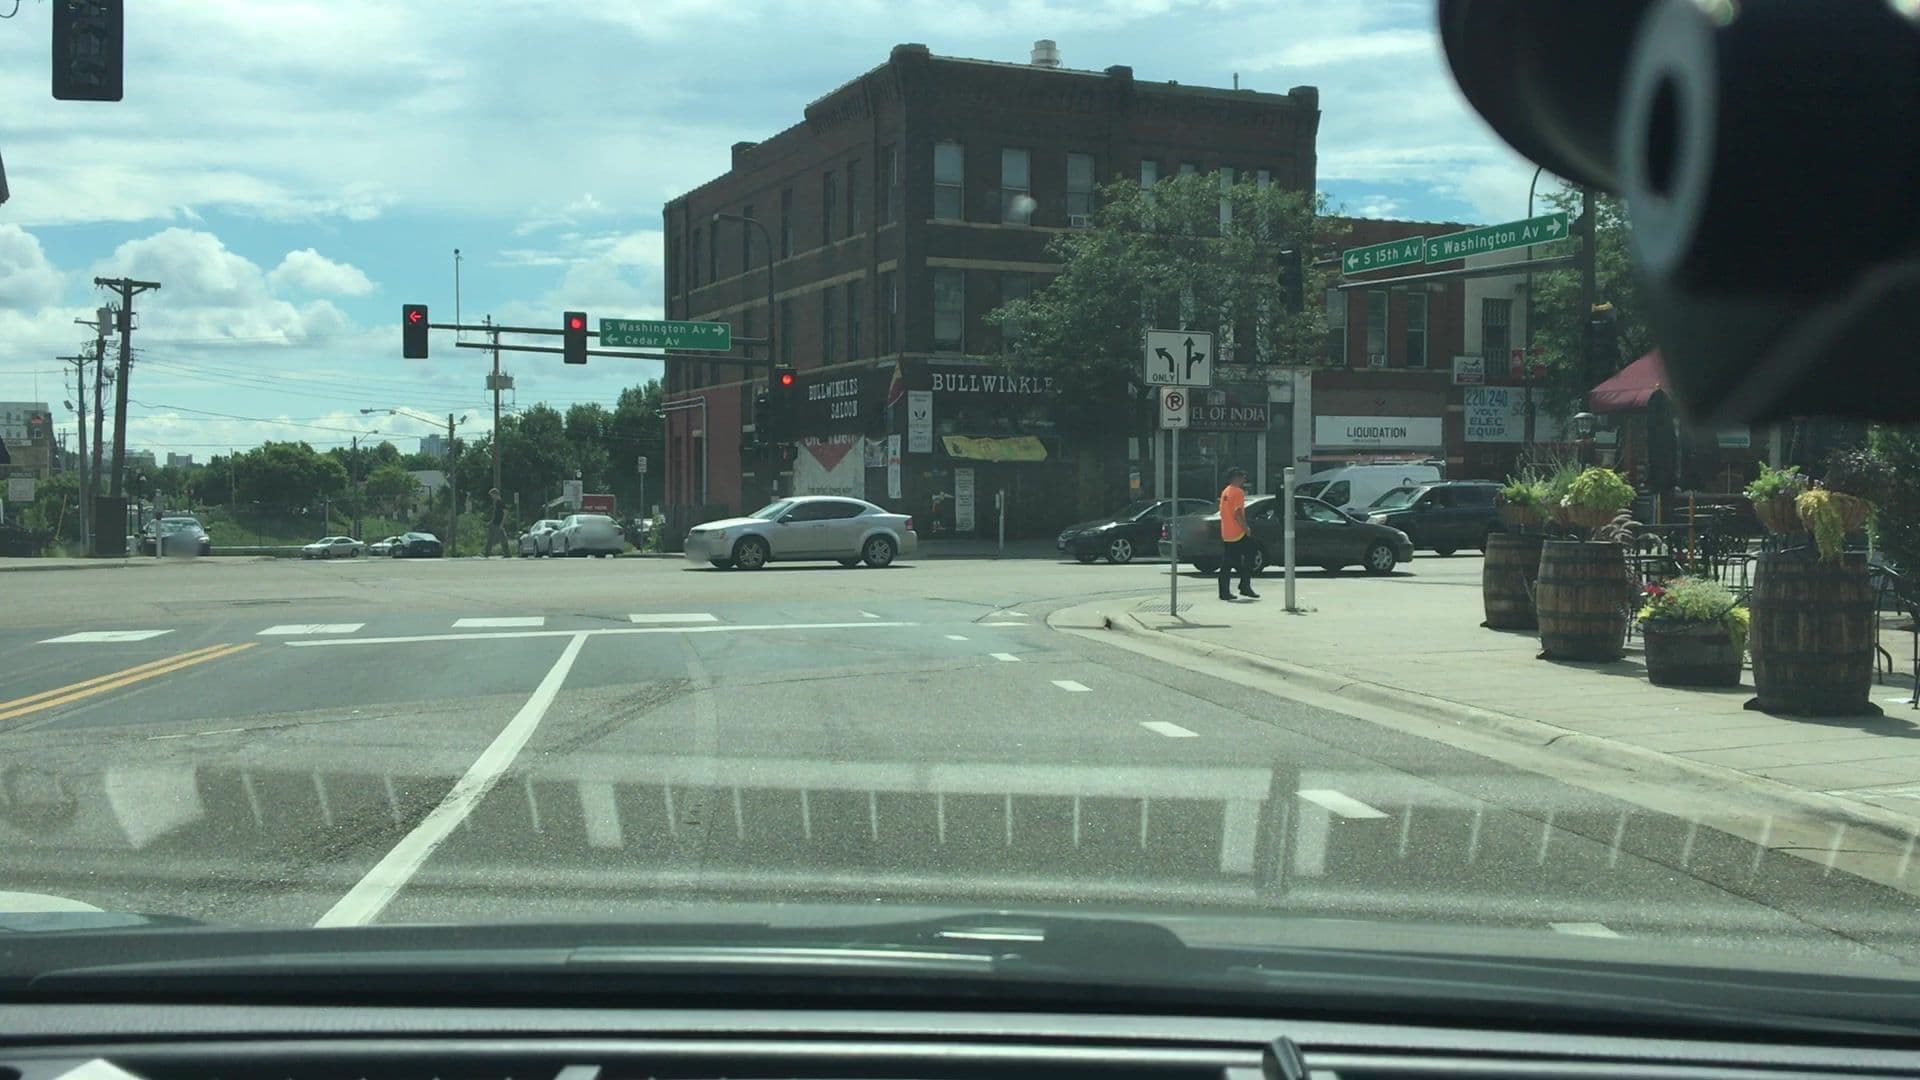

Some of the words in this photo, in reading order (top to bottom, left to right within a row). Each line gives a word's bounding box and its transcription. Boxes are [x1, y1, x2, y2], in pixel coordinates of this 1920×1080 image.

[1431, 244, 1438, 257] S
[1444, 231, 1516, 253] Washington
[1522, 226, 1539, 239] Av
[1364, 252, 1371, 264] S
[1376, 250, 1398, 263] 15th
[1404, 245, 1419, 258] Av
[605, 322, 613, 331] S
[618, 322, 686, 335] Washington
[692, 325, 707, 334] Av
[624, 335, 658, 345] Cedar
[665, 337, 680, 346] Av
[932, 373, 1063, 394] BULLWINKLE
[1152, 373, 1175, 383] ONLY
[1466, 389, 1509, 406] 220/240
[831, 400, 858, 419] SALOON
[1192, 407, 1206, 420] EL
[1210, 407, 1226, 420] OF
[1231, 407, 1265, 421] INDIA
[1347, 426, 1407, 438] LIQUIDATION
